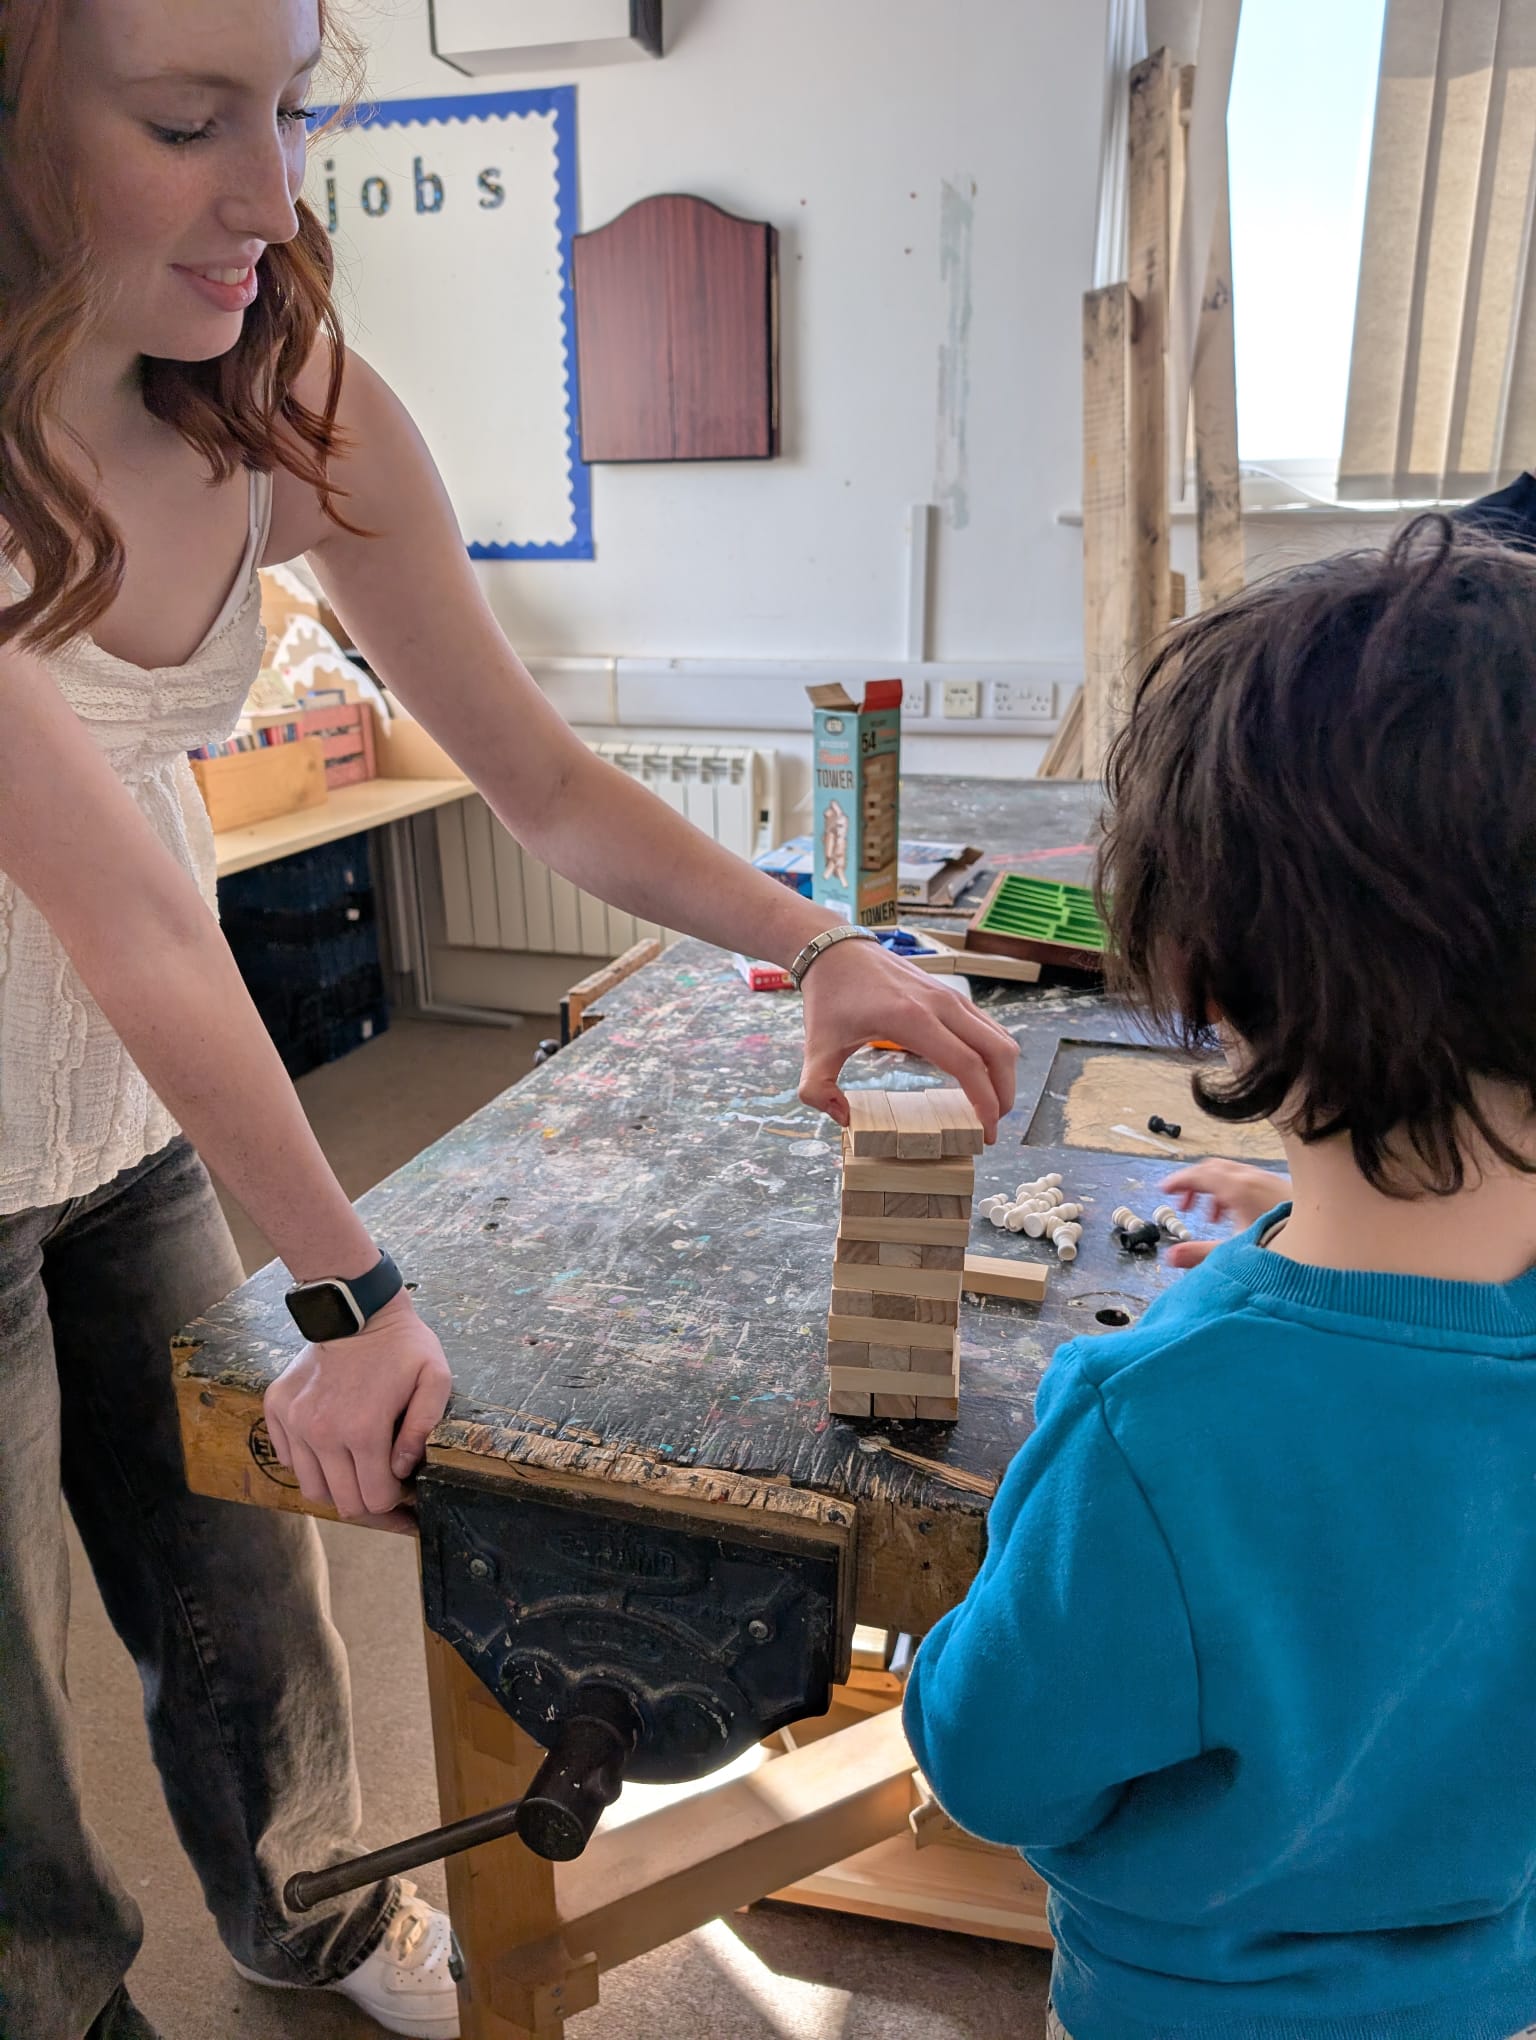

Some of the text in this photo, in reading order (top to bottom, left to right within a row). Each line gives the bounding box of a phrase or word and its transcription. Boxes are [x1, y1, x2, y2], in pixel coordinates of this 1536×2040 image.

[325, 156, 505, 233] jobs
[816, 768, 854, 790] TOWER
[860, 900, 896, 926] TOWER
